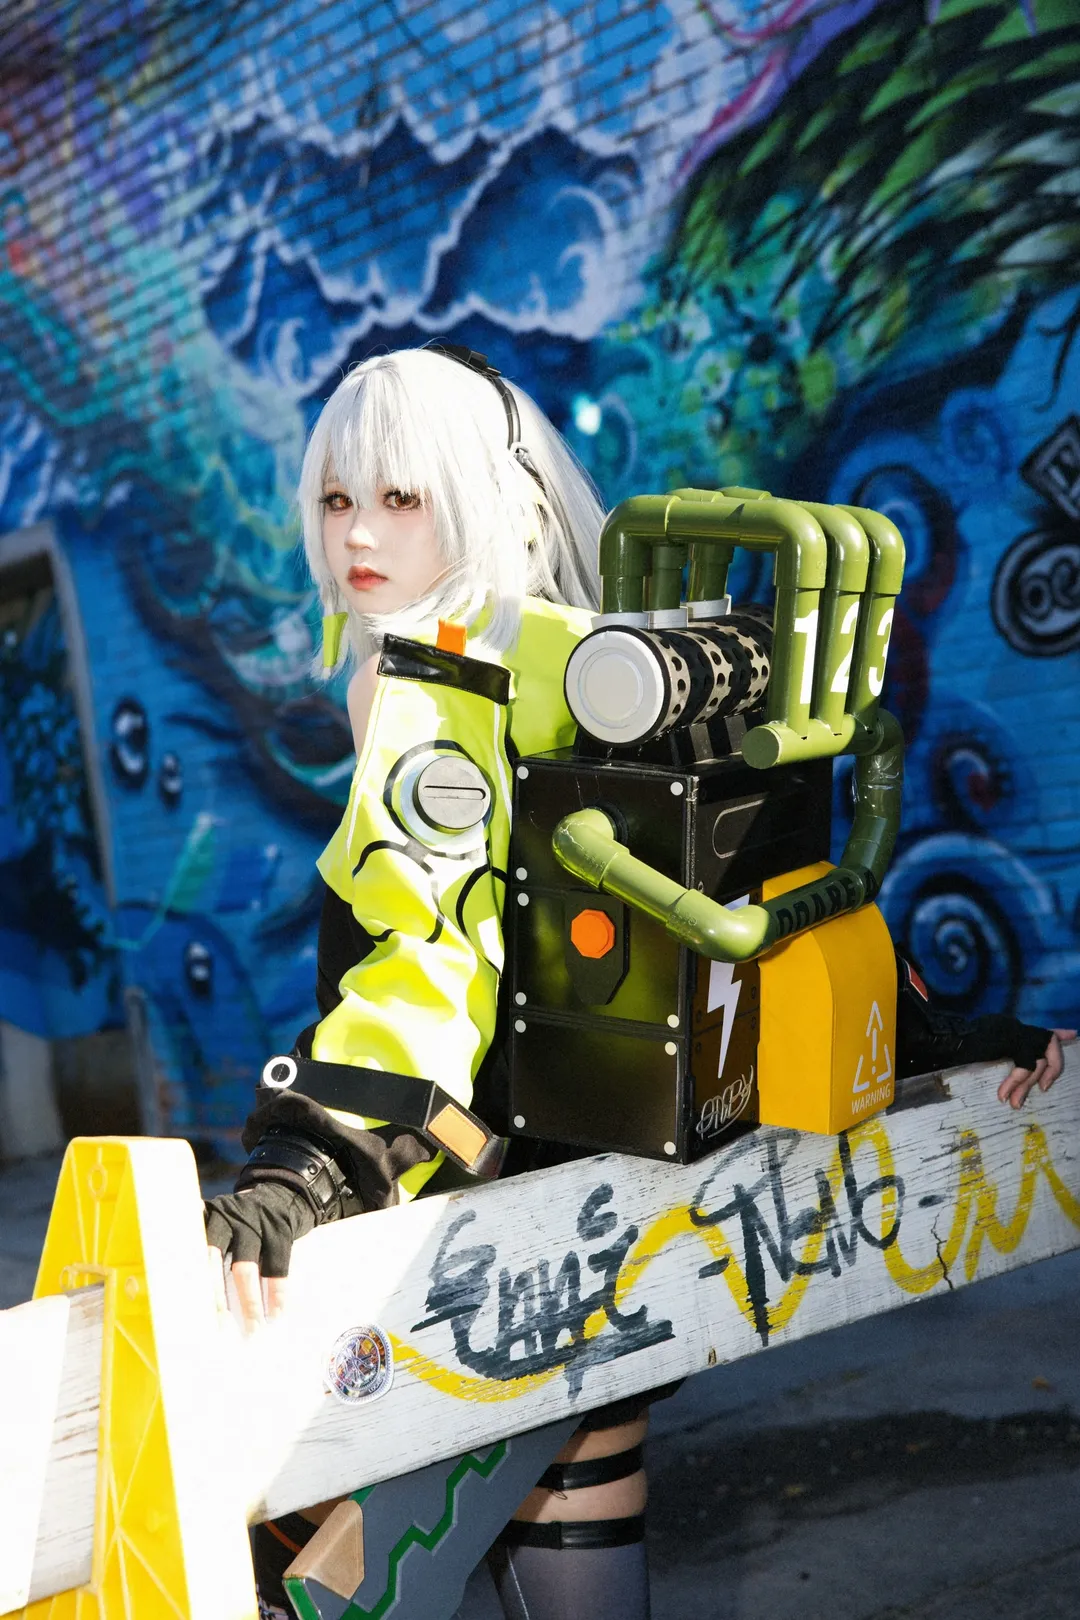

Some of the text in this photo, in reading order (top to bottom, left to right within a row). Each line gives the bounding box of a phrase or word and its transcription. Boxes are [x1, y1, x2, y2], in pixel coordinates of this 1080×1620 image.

[793, 601, 894, 704] 1 2 3
[851, 1083, 891, 1115] WARNING
